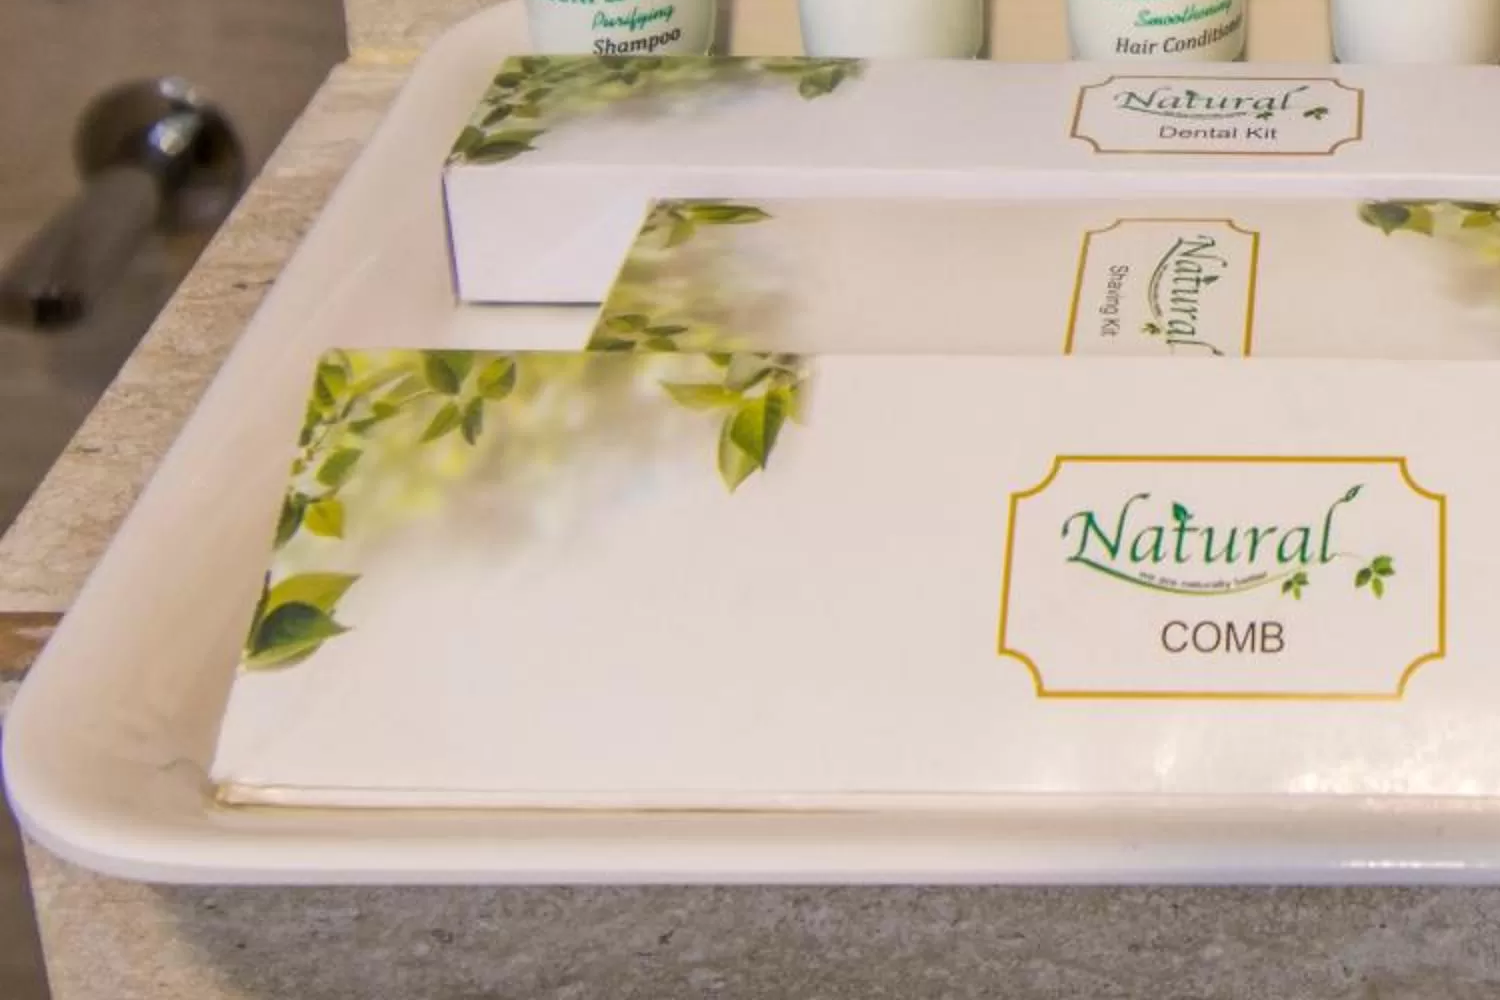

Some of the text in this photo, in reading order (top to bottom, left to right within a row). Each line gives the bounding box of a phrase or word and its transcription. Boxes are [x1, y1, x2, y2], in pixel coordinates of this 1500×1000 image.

[592, 4, 675, 32] Purifying
[593, 28, 681, 55] Shampoo
[1116, 37, 1159, 55] Hair
[1114, 85, 1309, 110] Natural
[1159, 125, 1277, 139] Dental Kit
[1099, 265, 1129, 315] Shaving
[1166, 234, 1228, 356] Natural
[1062, 484, 1364, 565] Natural
[1160, 621, 1286, 655] COMB
